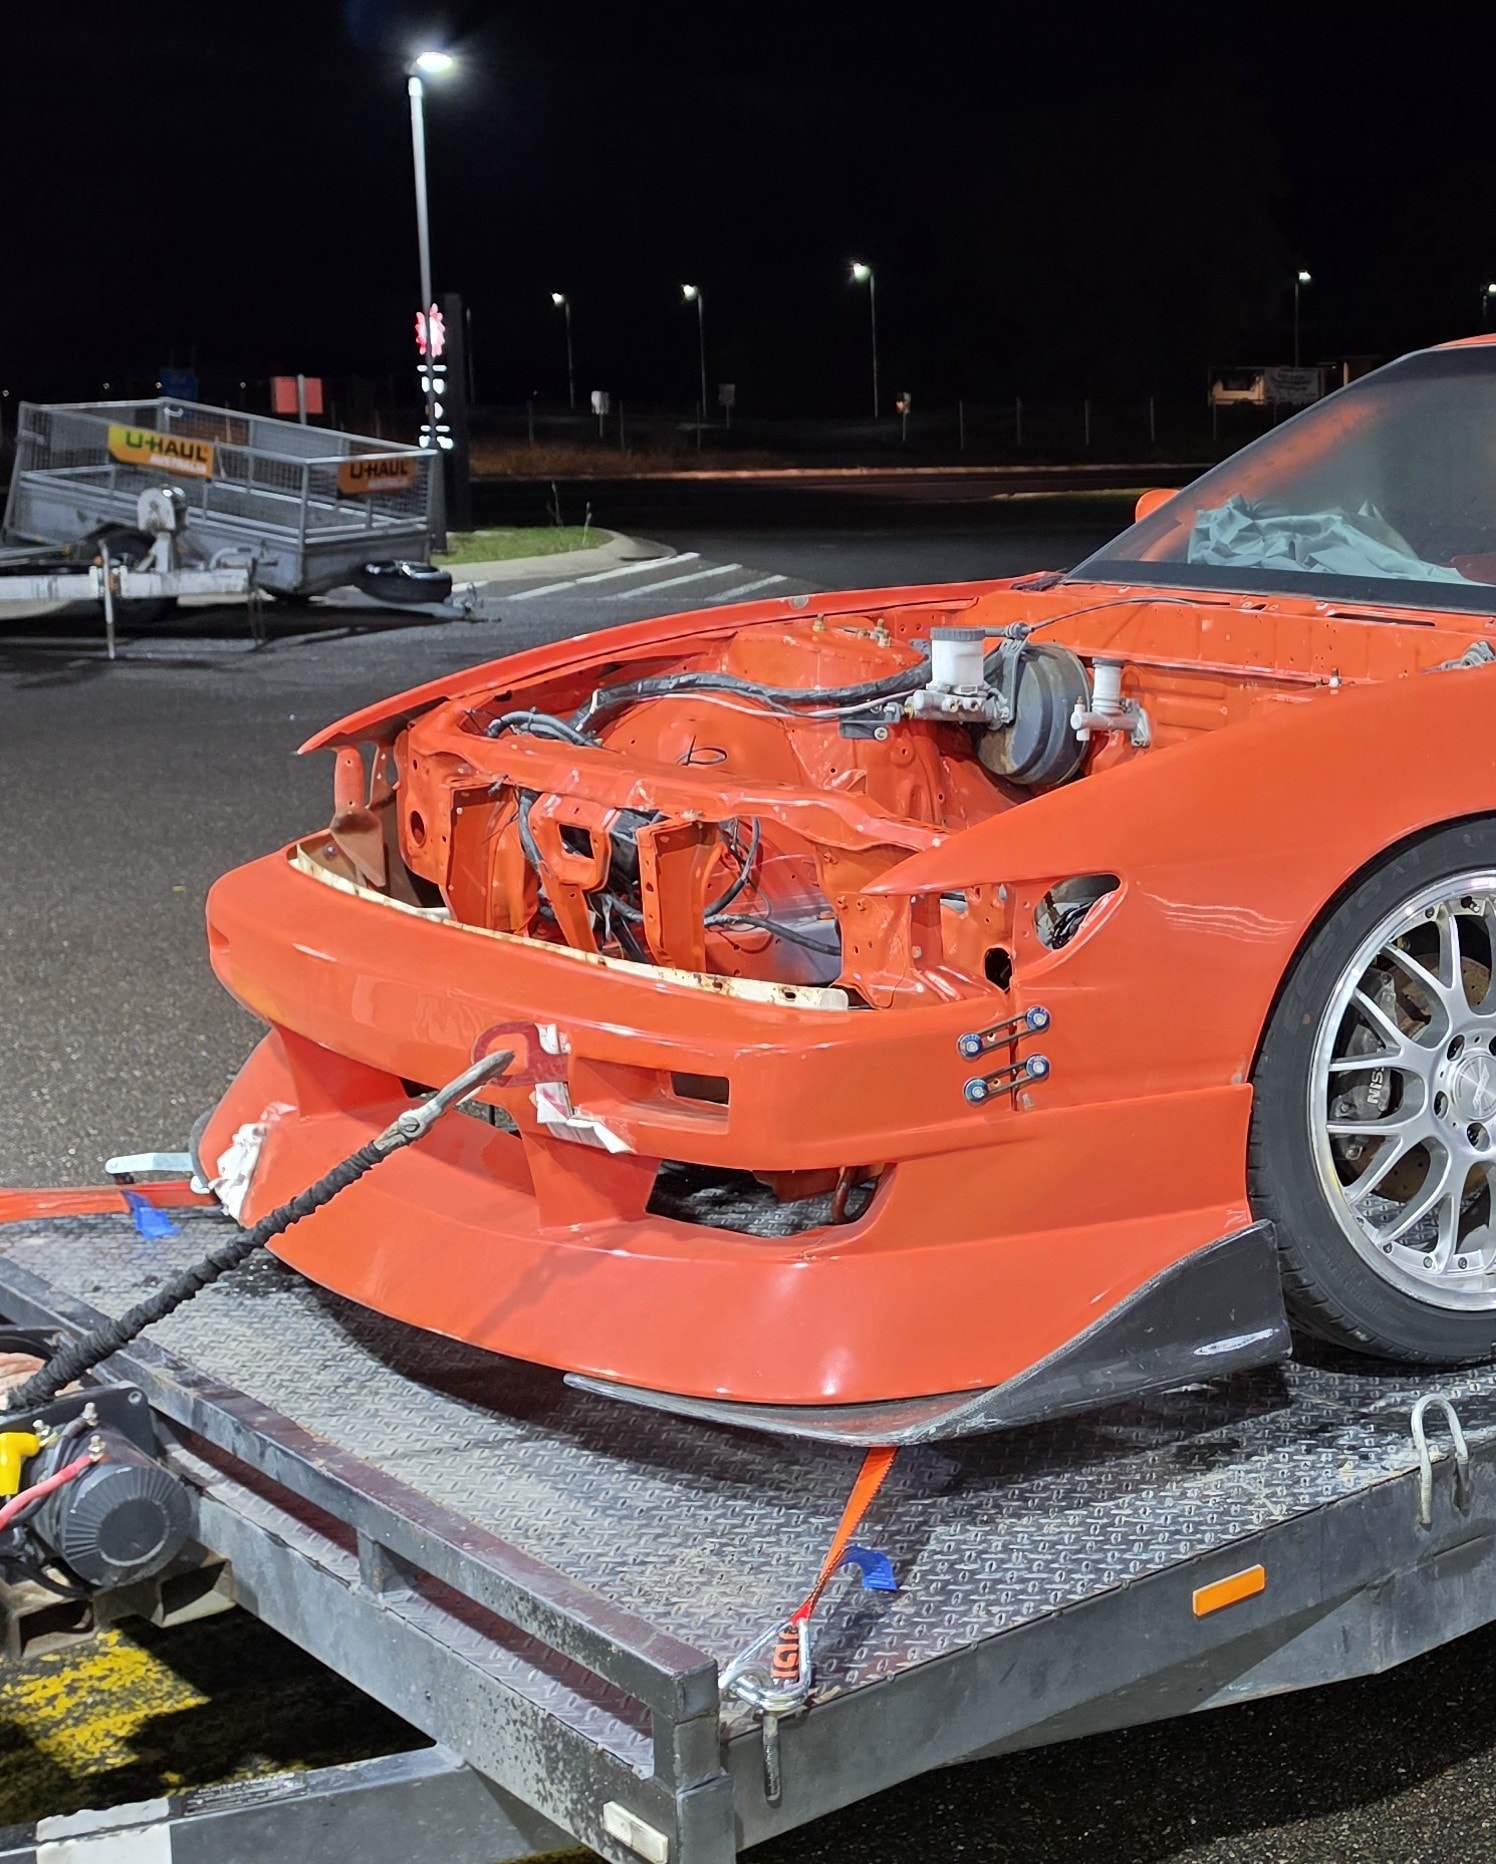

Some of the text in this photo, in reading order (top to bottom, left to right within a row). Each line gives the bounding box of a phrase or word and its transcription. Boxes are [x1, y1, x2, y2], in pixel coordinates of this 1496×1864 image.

[125, 430, 208, 463] U-HAUL
[350, 459, 408, 479] U-HAUL
[1367, 1067, 1384, 1104] NIS
